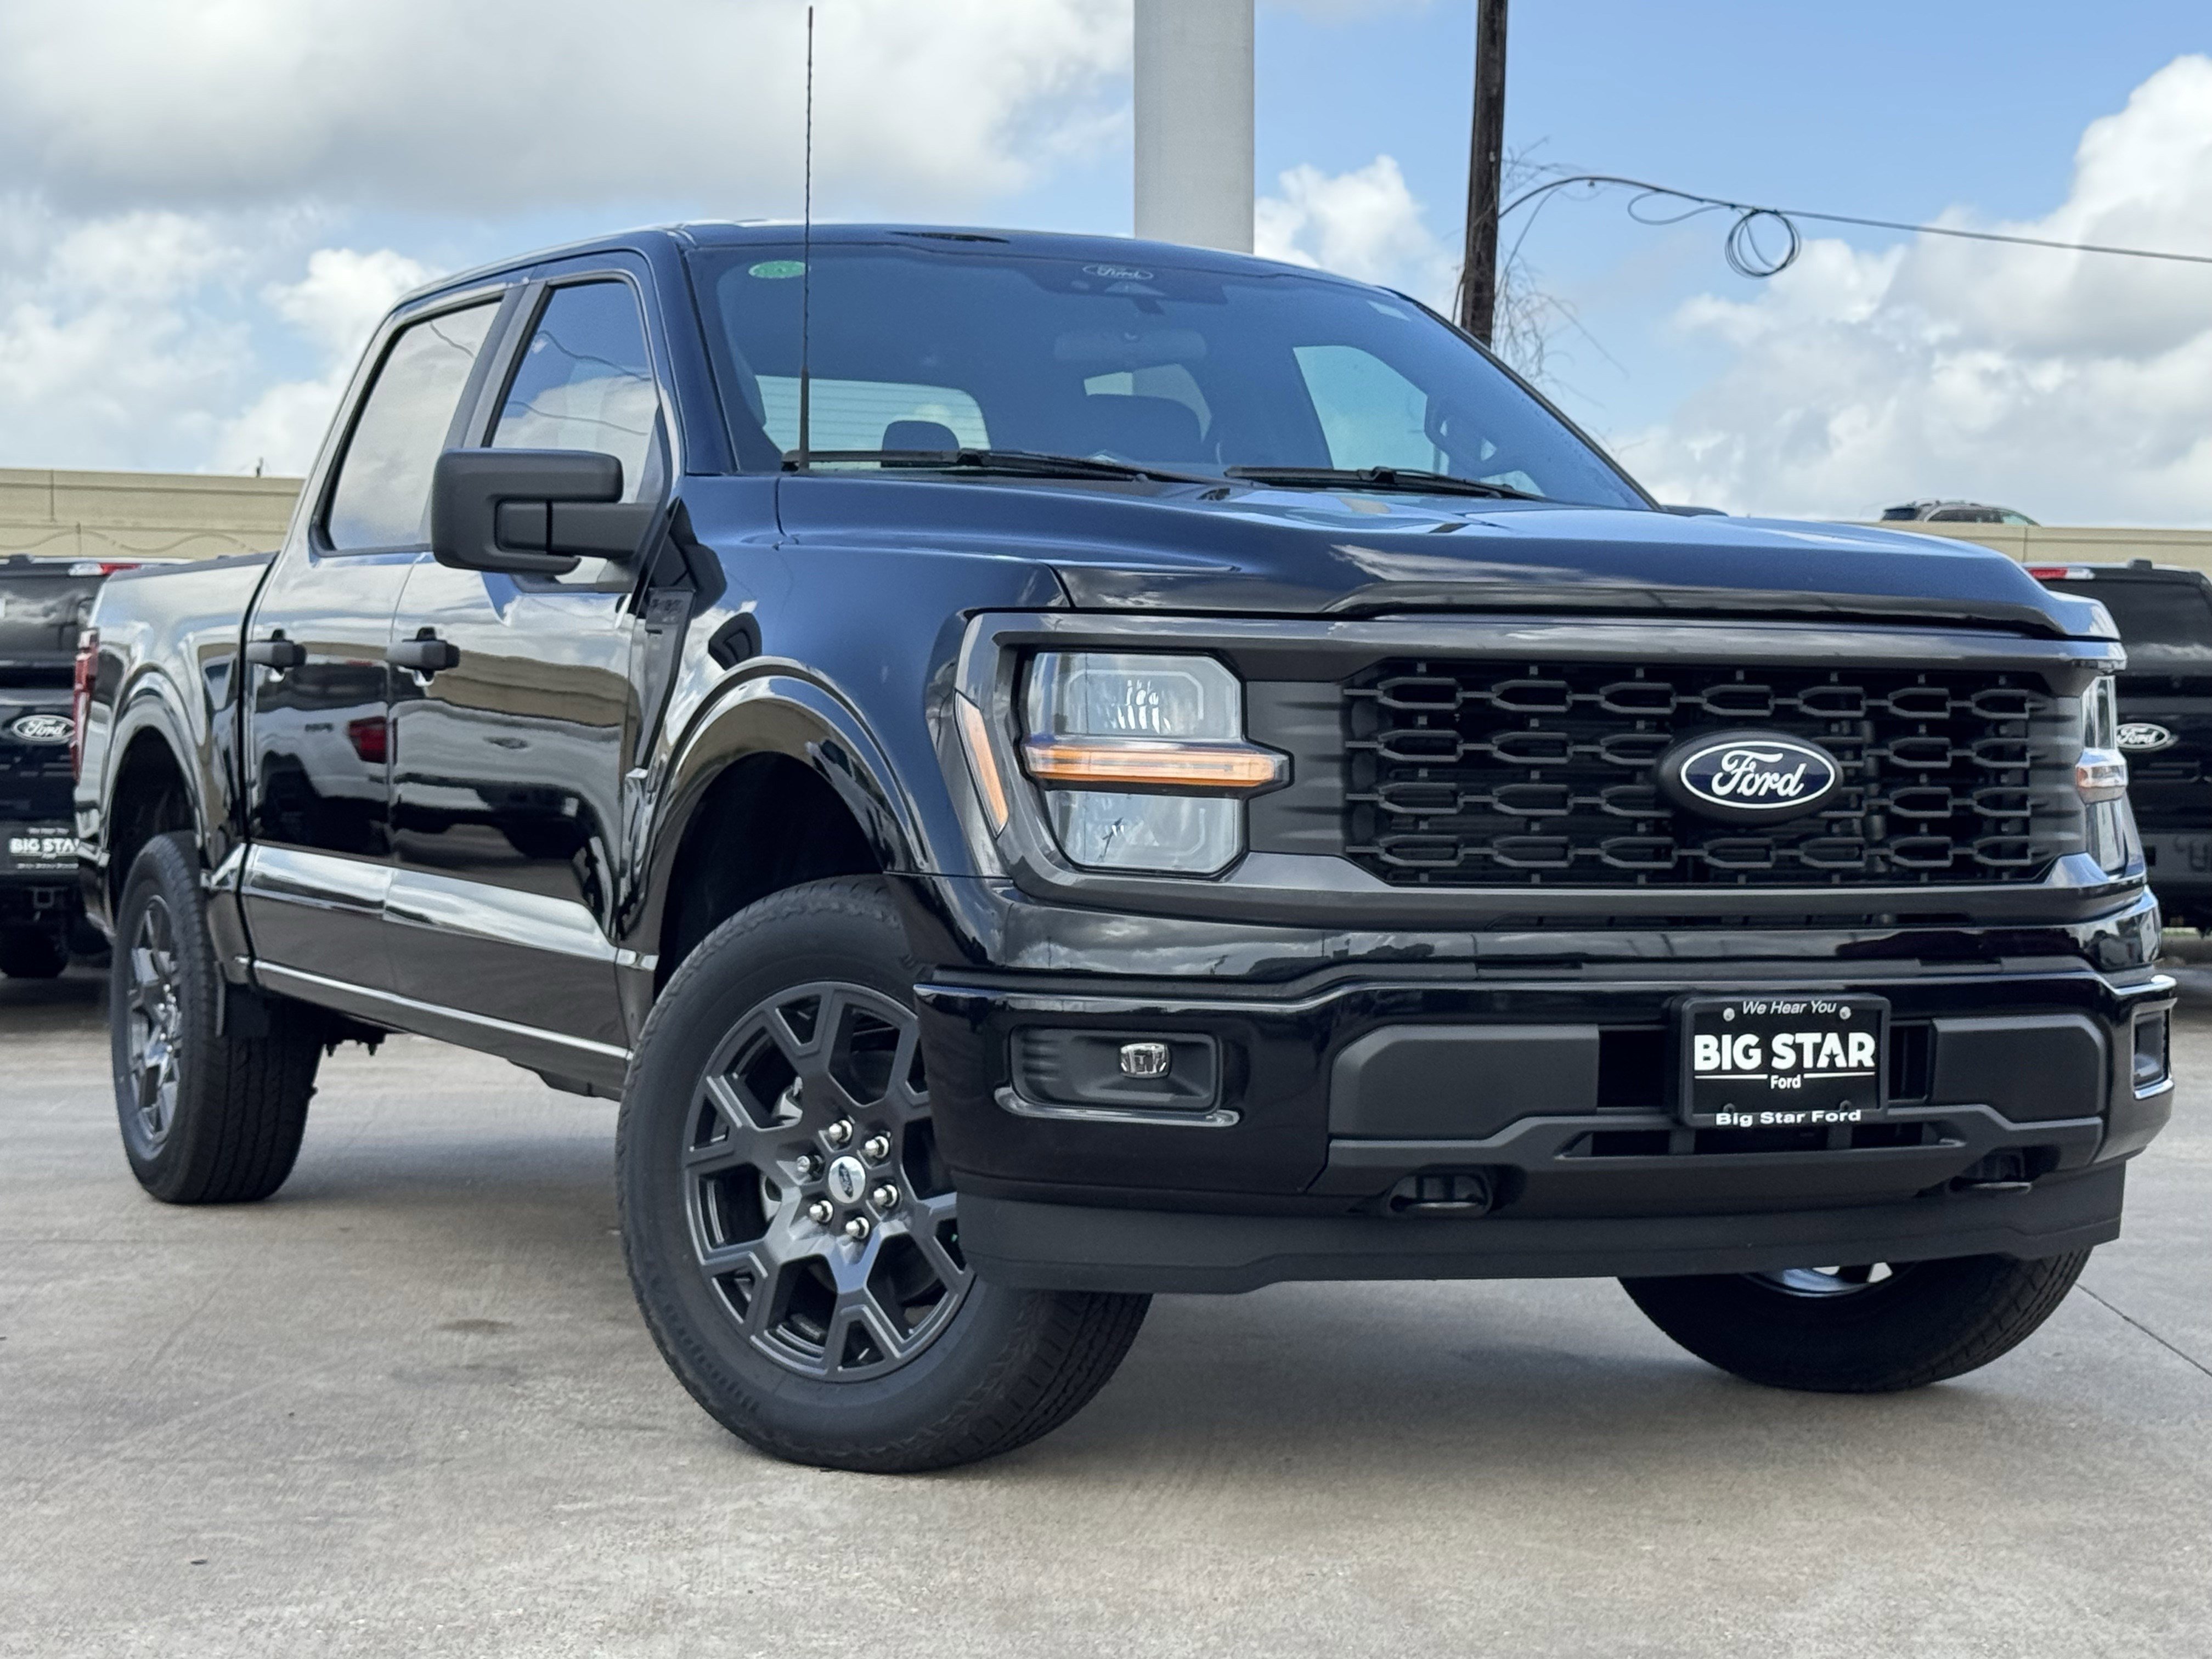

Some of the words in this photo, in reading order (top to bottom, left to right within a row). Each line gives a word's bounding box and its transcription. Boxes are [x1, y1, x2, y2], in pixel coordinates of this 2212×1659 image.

[24, 719, 66, 736] Ford
[1712, 750, 1807, 796] Ford
[10, 838, 40, 853] BIG
[42, 838, 80, 853] STA
[1742, 1001, 1766, 1014] We
[1770, 1001, 1807, 1015] Hear
[1810, 1000, 1837, 1014] You
[1694, 1033, 1762, 1071] BIG
[1771, 1032, 1876, 1070] STAR
[1770, 1075, 1802, 1090] Ford
[1716, 1113, 1753, 1127] Big
[1760, 1111, 1806, 1125] Star
[1812, 1109, 1861, 1122] Ford
